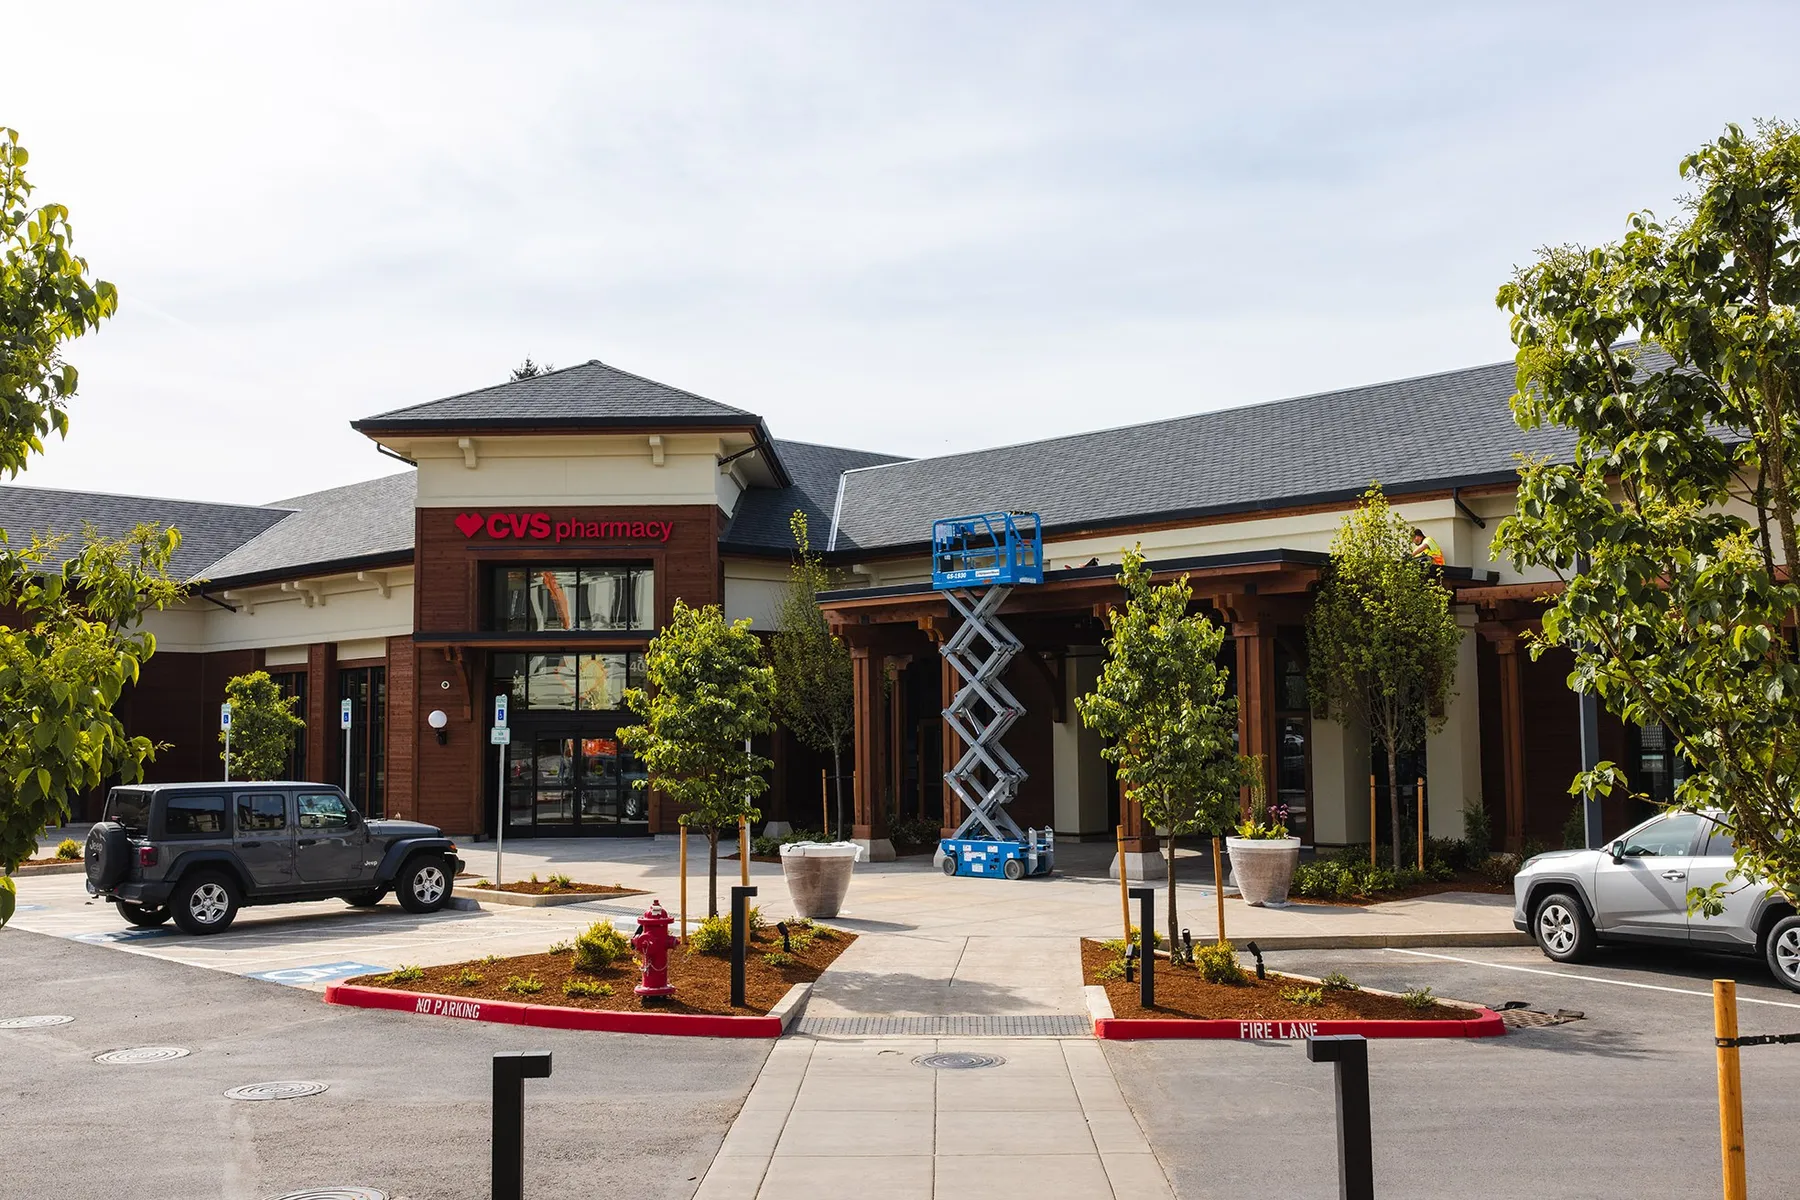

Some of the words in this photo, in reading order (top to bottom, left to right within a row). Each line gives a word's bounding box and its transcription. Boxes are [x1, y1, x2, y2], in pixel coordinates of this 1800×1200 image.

[486, 512, 551, 539] CVS
[555, 517, 674, 543] pharmacy
[90, 840, 103, 854] Jeep
[415, 998, 431, 1013] NO
[434, 1000, 480, 1019] PARKING
[1240, 1022, 1273, 1039] FIRE
[1278, 1022, 1318, 1039] LANE
